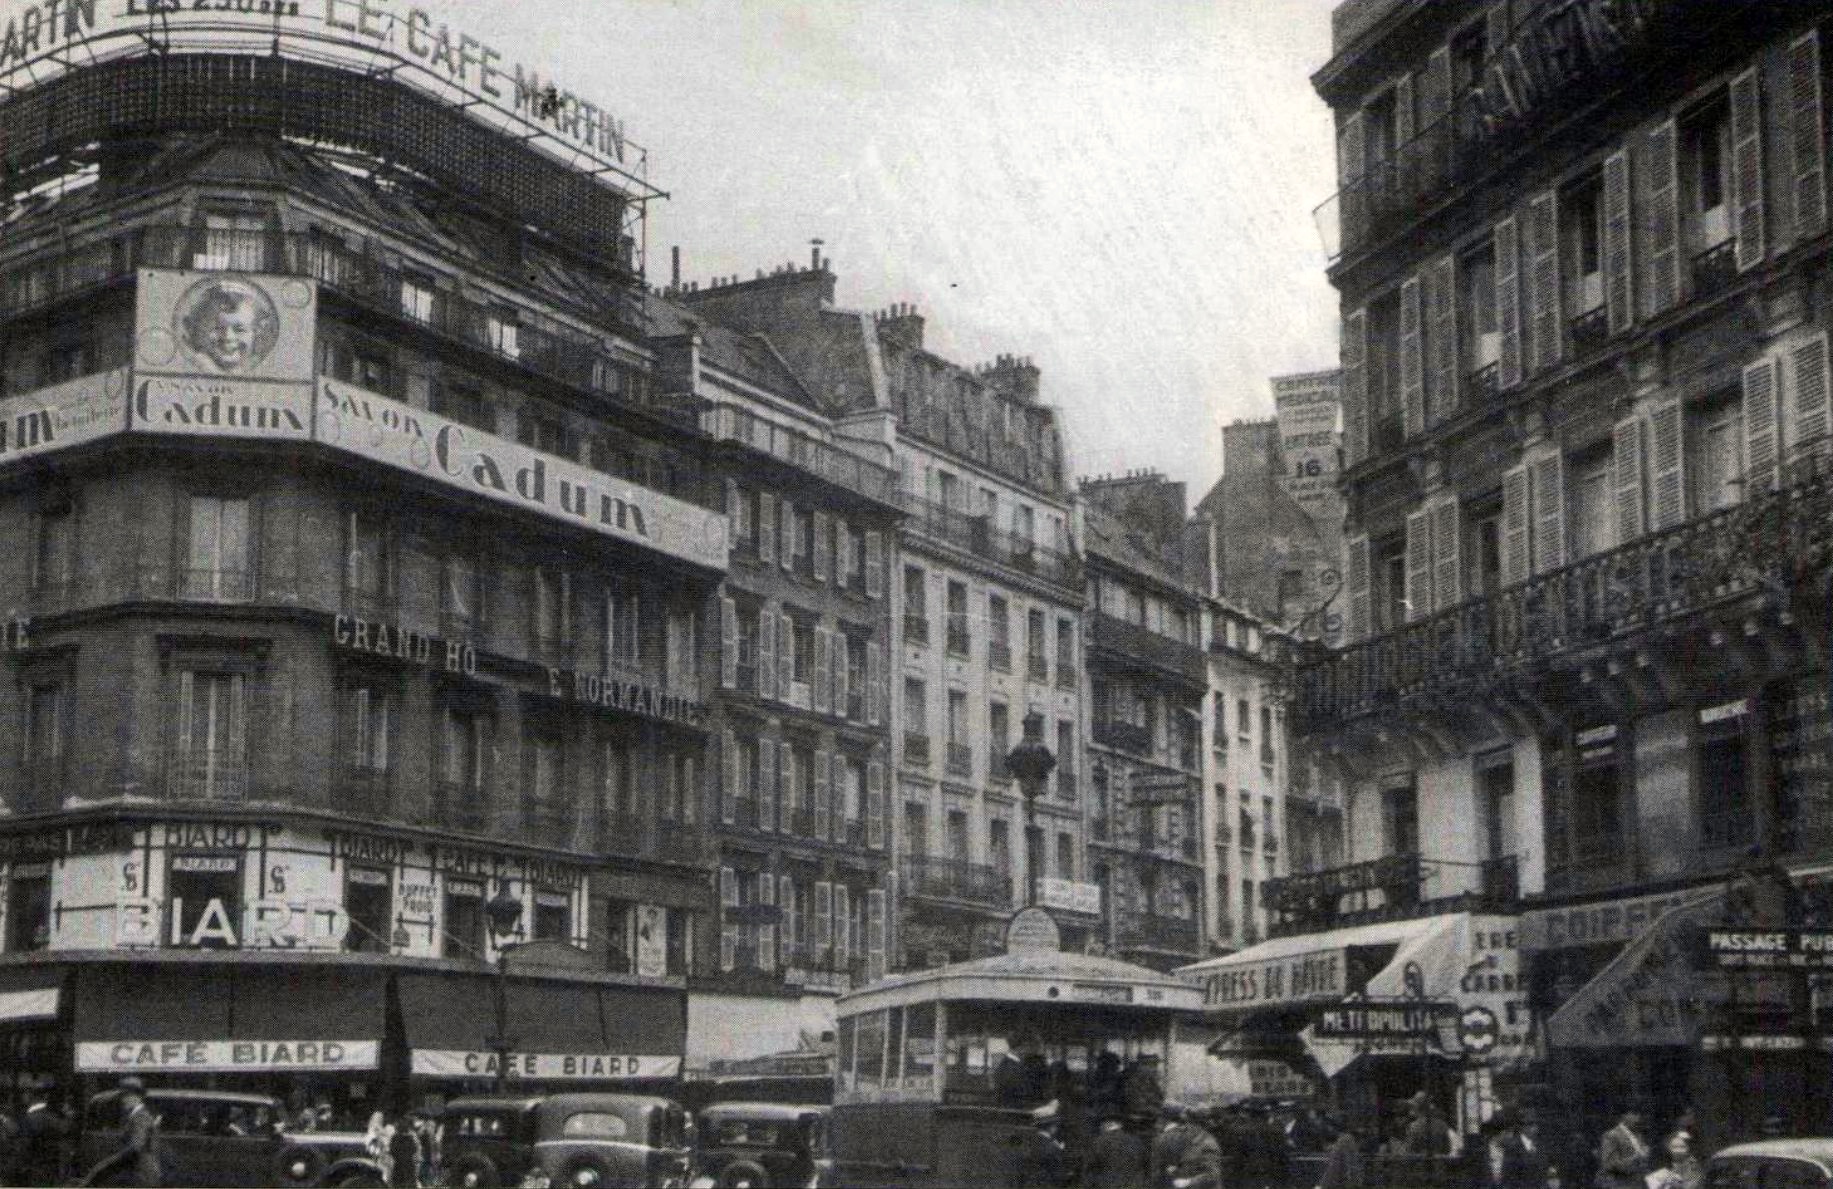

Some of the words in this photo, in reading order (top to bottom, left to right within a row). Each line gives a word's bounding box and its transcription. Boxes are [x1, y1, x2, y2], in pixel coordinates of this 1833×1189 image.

[408, 8, 501, 98] CAFE
[513, 61, 624, 164] MARTIN
[136, 379, 303, 431] Cadum
[434, 424, 649, 538] Cadum
[1295, 459, 1321, 478] 16
[334, 612, 430, 665] GRAND
[574, 671, 700, 727] NORMANDIE
[116, 896, 351, 948] BIARD
[1709, 933, 1787, 951] PASSAGE
[111, 1043, 208, 1066] CAFE
[233, 1042, 345, 1065] BIARD
[464, 1051, 536, 1076] CAFE
[562, 1055, 640, 1077] BIARD
